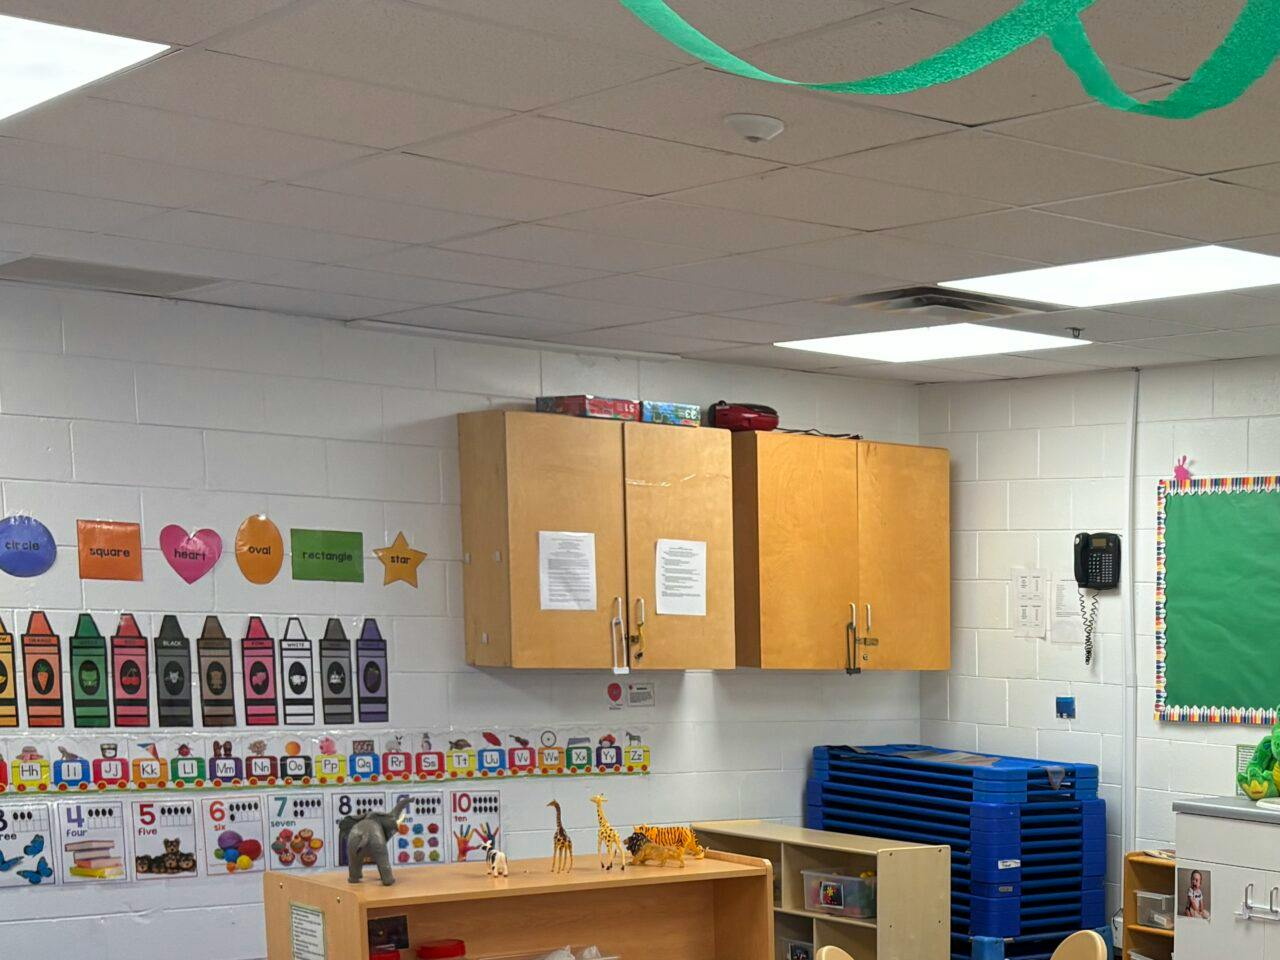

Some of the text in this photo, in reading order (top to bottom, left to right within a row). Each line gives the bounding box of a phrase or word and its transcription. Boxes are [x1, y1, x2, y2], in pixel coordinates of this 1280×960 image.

[5, 541, 39, 551] circle
[248, 546, 271, 555] oval
[90, 547, 130, 558] square
[174, 548, 206, 561] heart
[302, 551, 353, 563] rectangle
[390, 554, 411, 564] star
[274, 797, 287, 818] 7
[338, 795, 352, 816] 8
[452, 793, 472, 813] 10
[66, 805, 85, 828] 4
[139, 804, 156, 826] 5
[209, 800, 225, 822] 6
[213, 823, 226, 831] six
[270, 820, 297, 828] seven
[66, 829, 88, 837] four
[138, 827, 157, 836] five
